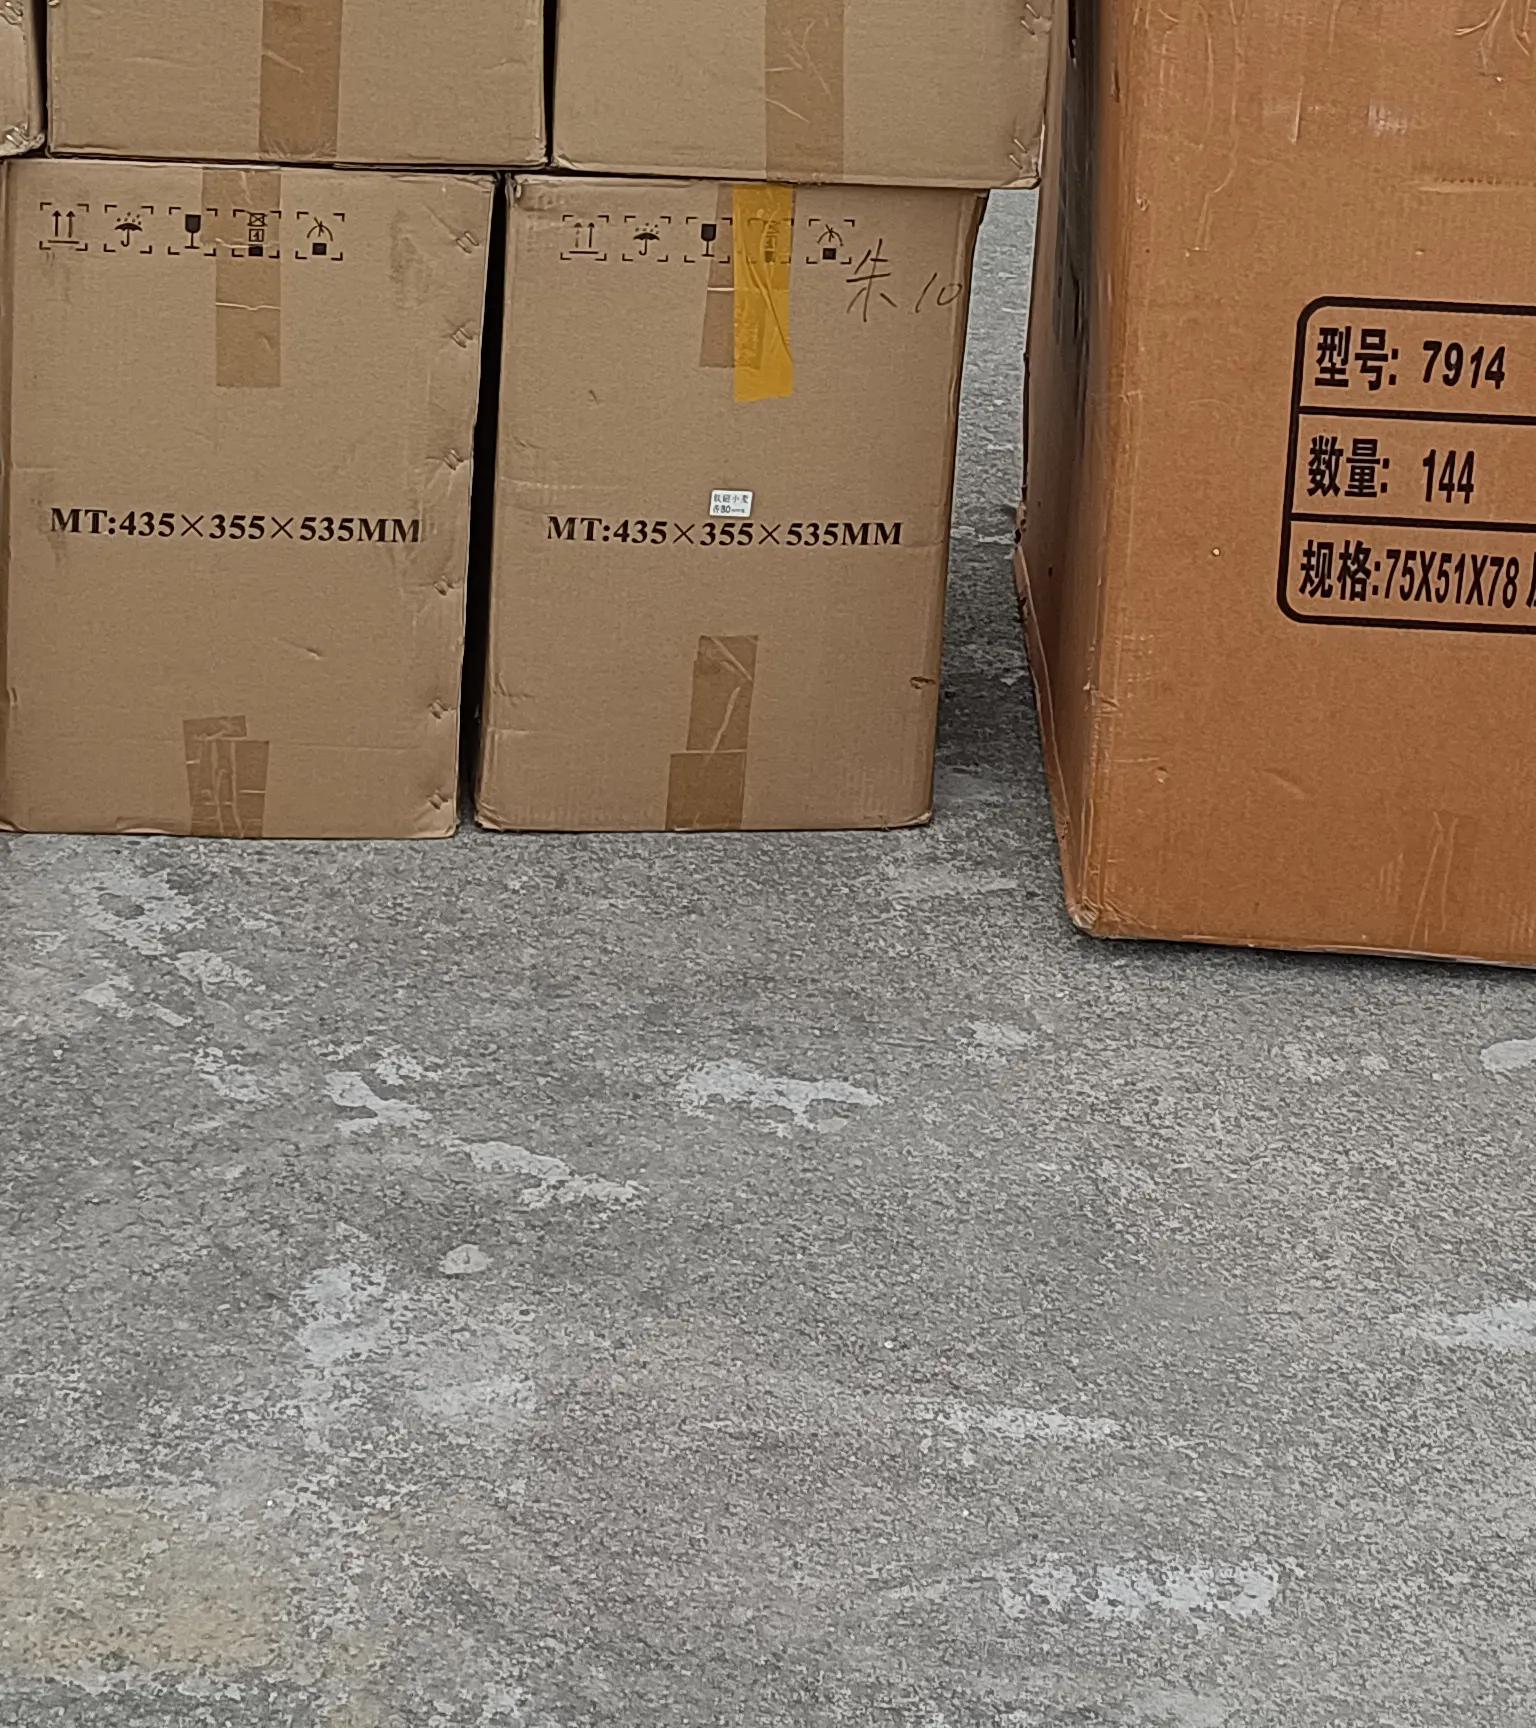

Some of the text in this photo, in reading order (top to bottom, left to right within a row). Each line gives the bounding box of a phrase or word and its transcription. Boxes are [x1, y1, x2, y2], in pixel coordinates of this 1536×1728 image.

[914, 271, 963, 314] 10
[1421, 340, 1508, 391] 7914
[1422, 449, 1476, 505] 144
